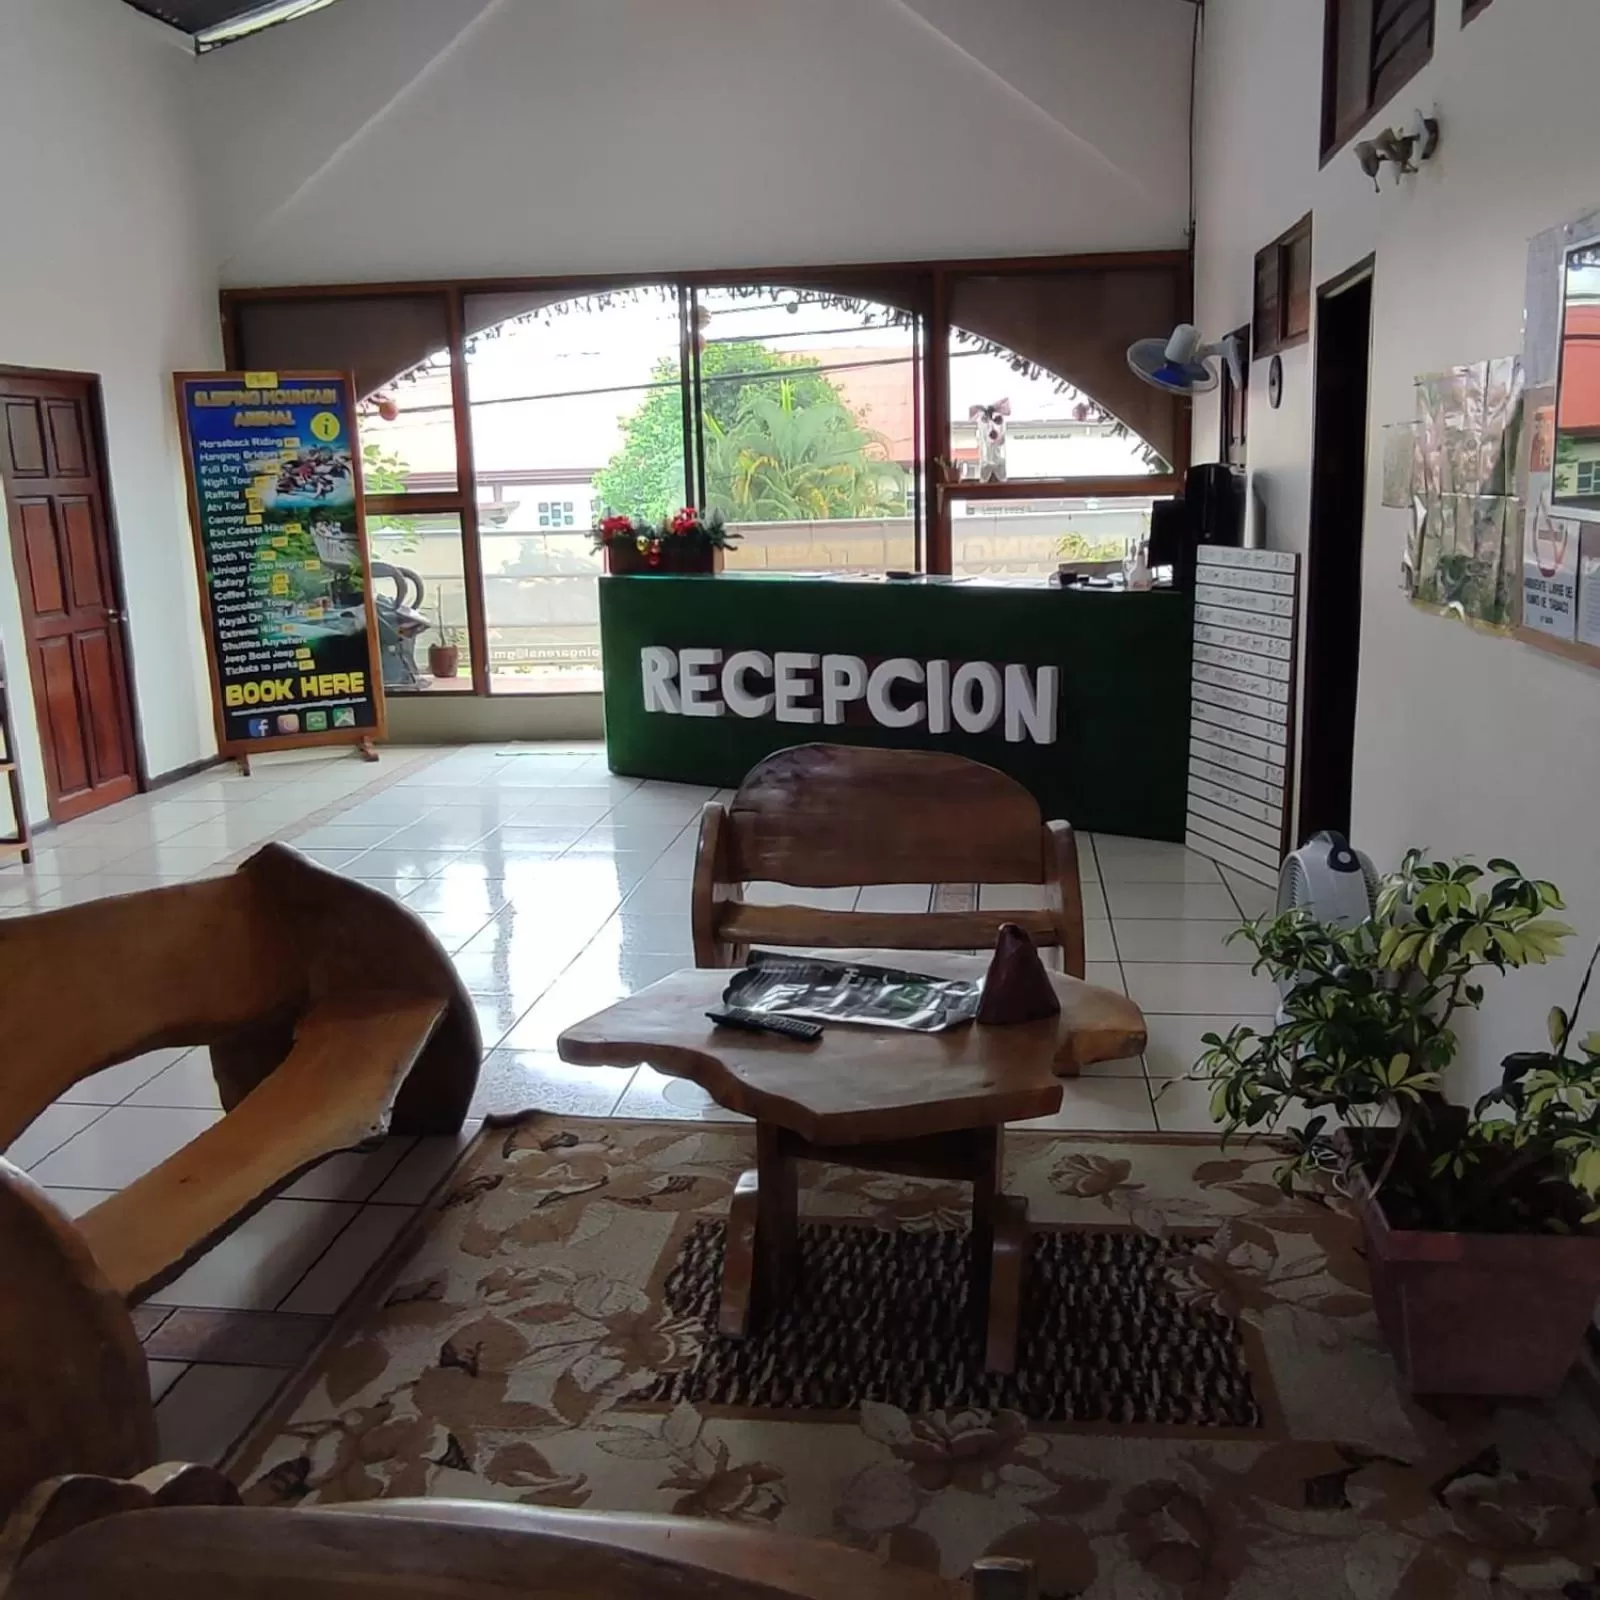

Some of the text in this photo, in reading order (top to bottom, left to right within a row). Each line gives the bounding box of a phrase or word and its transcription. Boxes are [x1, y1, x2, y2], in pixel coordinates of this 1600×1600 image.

[222, 463, 241, 474] Day
[204, 489, 239, 501] Rafting
[224, 501, 247, 511] Tour
[208, 514, 244, 525] Canopy
[211, 539, 248, 550] Volcano
[214, 590, 246, 601] Coffee
[218, 615, 247, 628] Kayak
[224, 653, 247, 665] Jeep
[272, 649, 295, 660] Jeep
[225, 672, 365, 706] BOOK HERE
[641, 645, 1059, 745] RECEPCION
